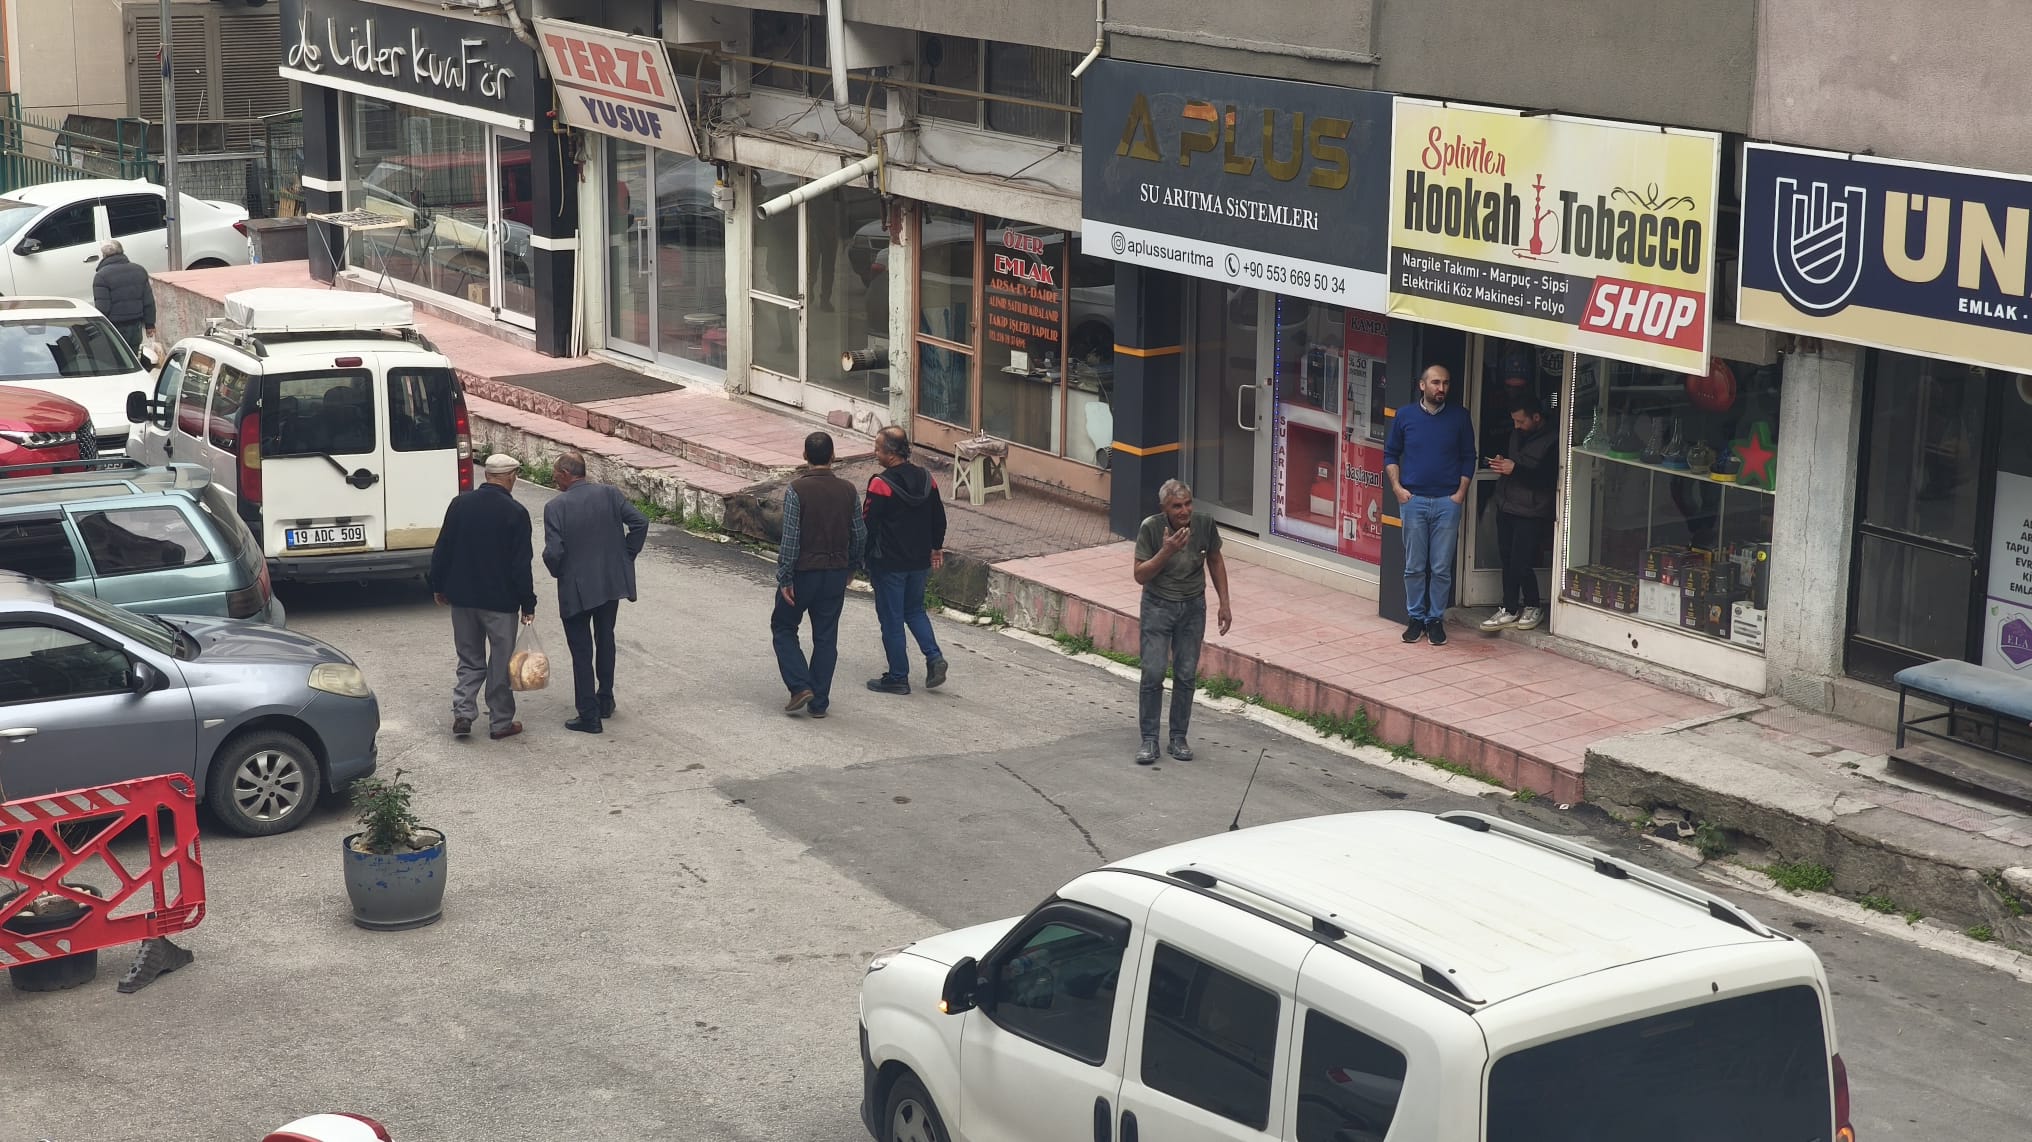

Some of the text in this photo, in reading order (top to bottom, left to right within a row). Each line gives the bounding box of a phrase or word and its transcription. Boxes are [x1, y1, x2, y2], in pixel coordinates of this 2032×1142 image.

[327, 17, 407, 78] Lider
[579, 95, 663, 139] YUSUF
[1421, 125, 1506, 177] Splinter
[1139, 183, 1160, 204] SU
[1162, 187, 1223, 214] ARITMA
[1404, 169, 1521, 246] Hookah
[1002, 226, 1045, 255] ÖZER
[1559, 190, 1702, 274] Tobacco
[1882, 190, 2032, 299] ÜN
[994, 253, 1055, 285] EMLAK
[1243, 261, 1346, 294] +90 553 669 50 34
[1402, 252, 1441, 273] Nargile
[1443, 260, 1480, 279] Takımı
[1489, 267, 1531, 290] Marpuç
[1541, 276, 1569, 295] Sipsi
[1401, 275, 1449, 295] Elektrikli
[1452, 282, 1473, 299] Köz
[1475, 286, 1524, 308] Makinesi
[1534, 297, 1566, 315] Folyo
[1589, 282, 1697, 340] SHOP
[1957, 298, 2018, 321] EMLAK
[294, 530, 308, 543] 19
[314, 529, 335, 542] ADC
[341, 527, 362, 540] 509
[2006, 541, 2030, 554] TAPU
